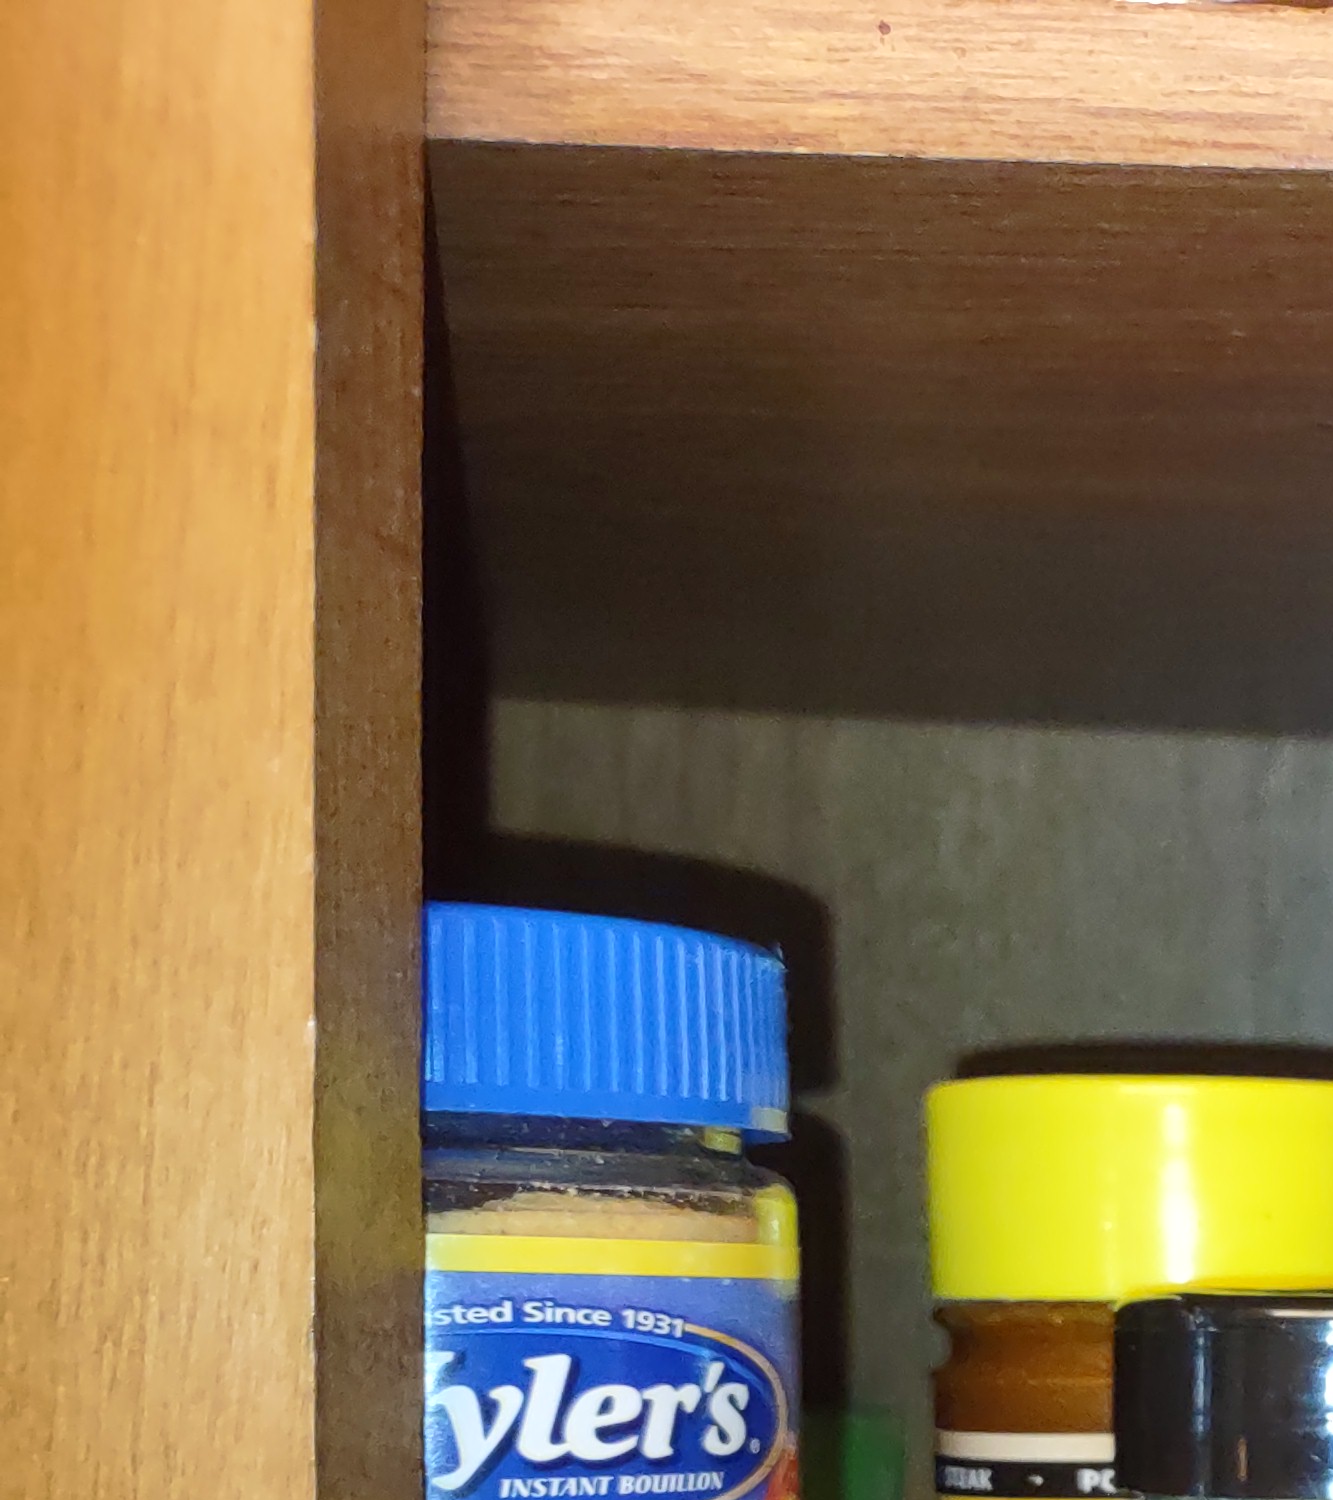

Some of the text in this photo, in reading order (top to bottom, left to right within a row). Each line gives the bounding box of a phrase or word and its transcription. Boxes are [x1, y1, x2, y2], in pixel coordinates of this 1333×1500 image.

[431, 1300, 685, 1338] sted Since 1931
[500, 1470, 724, 1500] INSTANT BOUILLON
